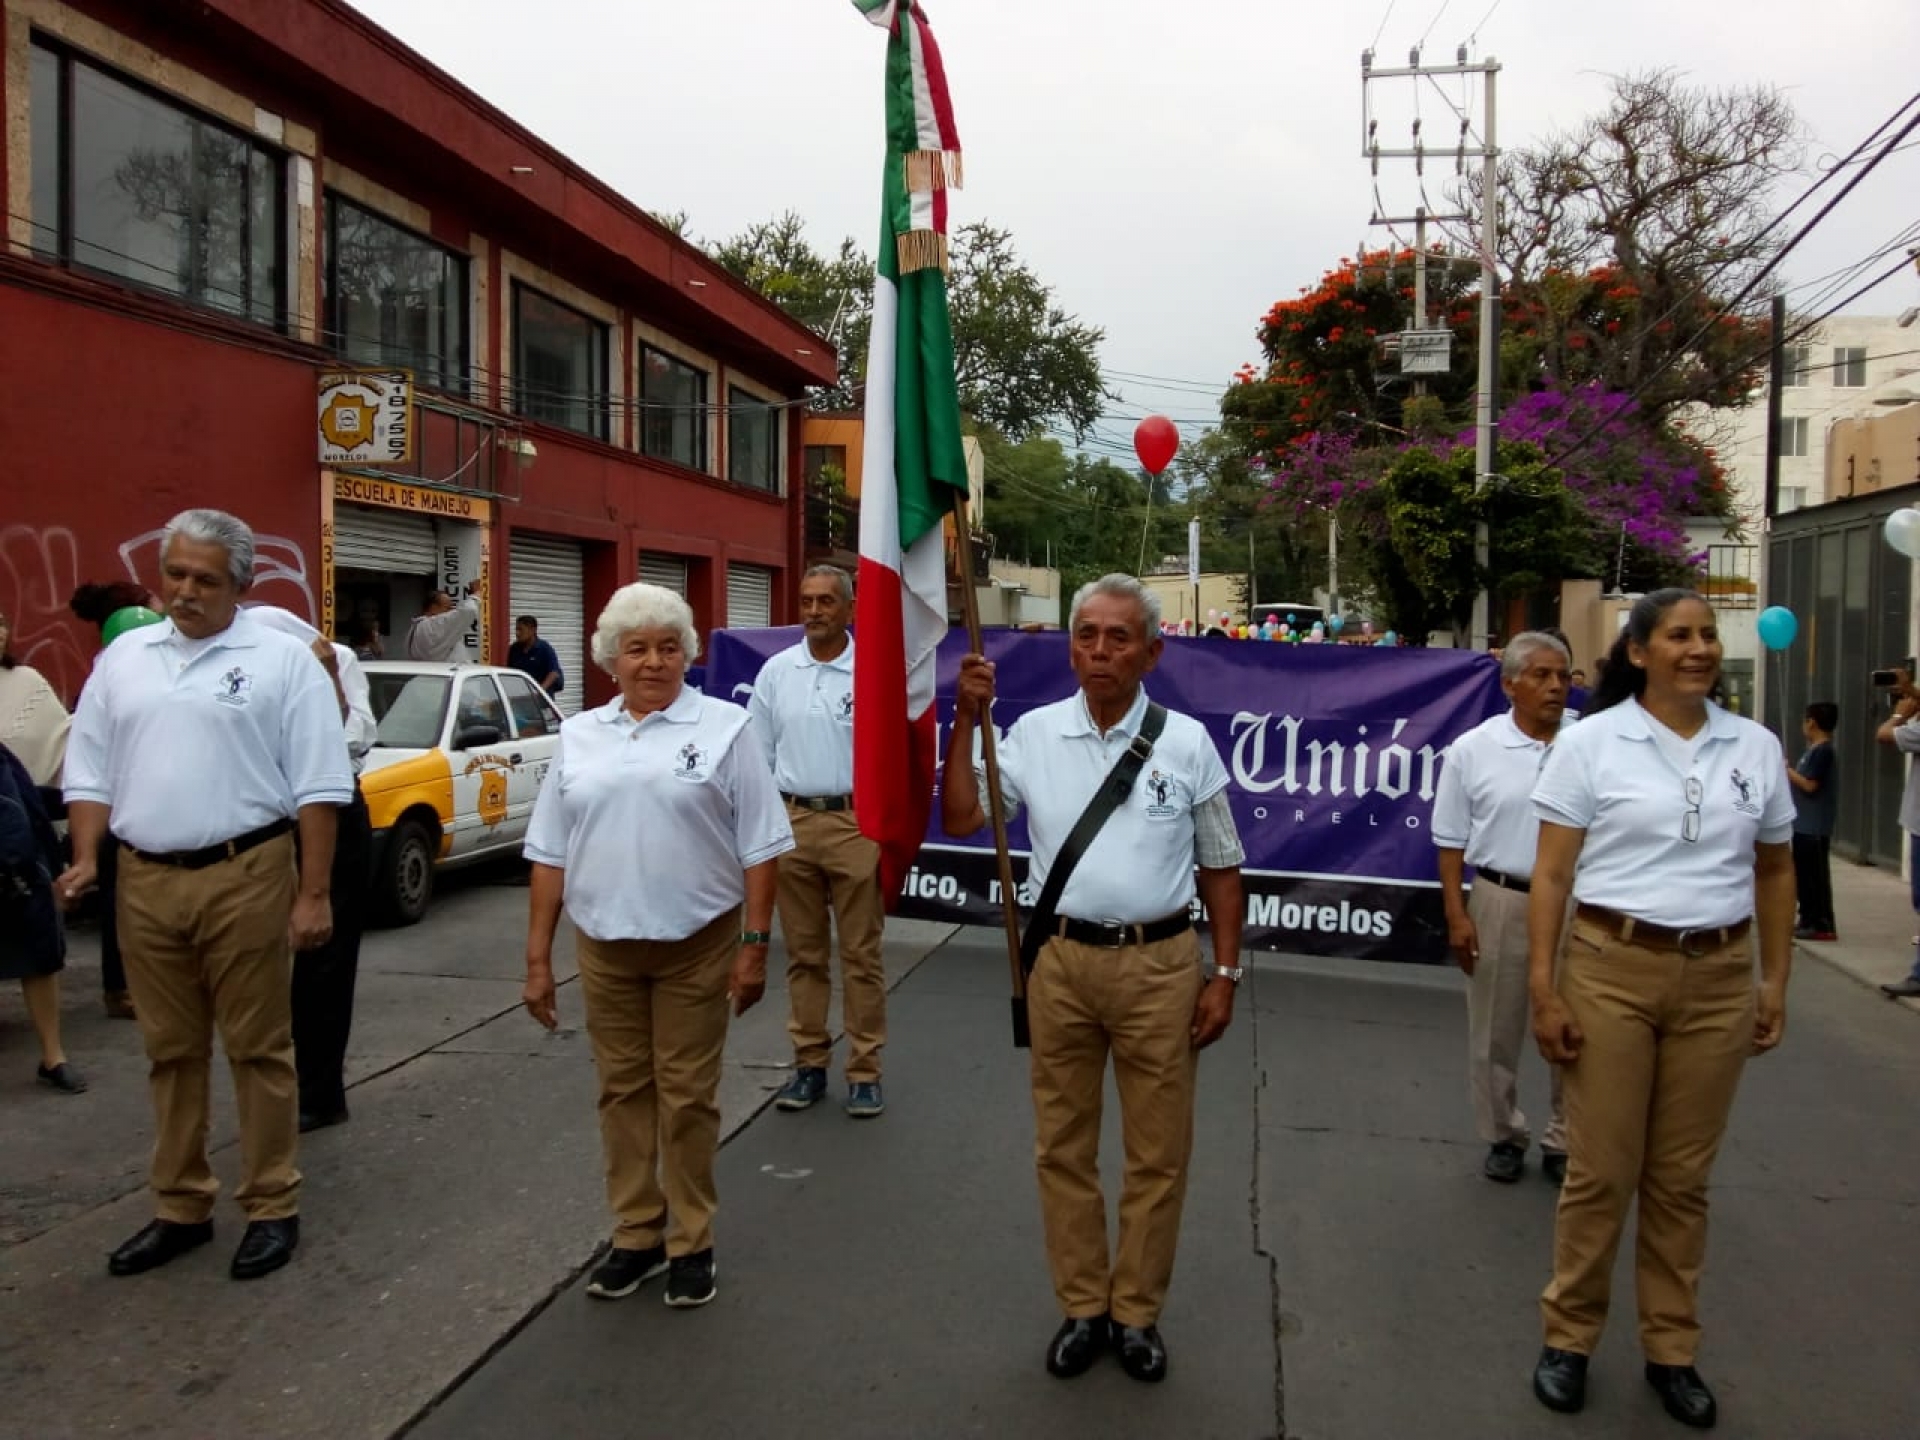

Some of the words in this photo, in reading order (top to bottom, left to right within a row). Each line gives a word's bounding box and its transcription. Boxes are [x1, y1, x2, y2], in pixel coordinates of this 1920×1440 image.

[335, 477, 397, 504] ESCUELA
[401, 489, 415, 507] DE
[420, 491, 471, 516] MANEJO
[1229, 709, 1446, 802] Unión
[1253, 806, 1420, 829] ORELO
[901, 865, 967, 905] ico,
[1247, 893, 1393, 938] Morelos
